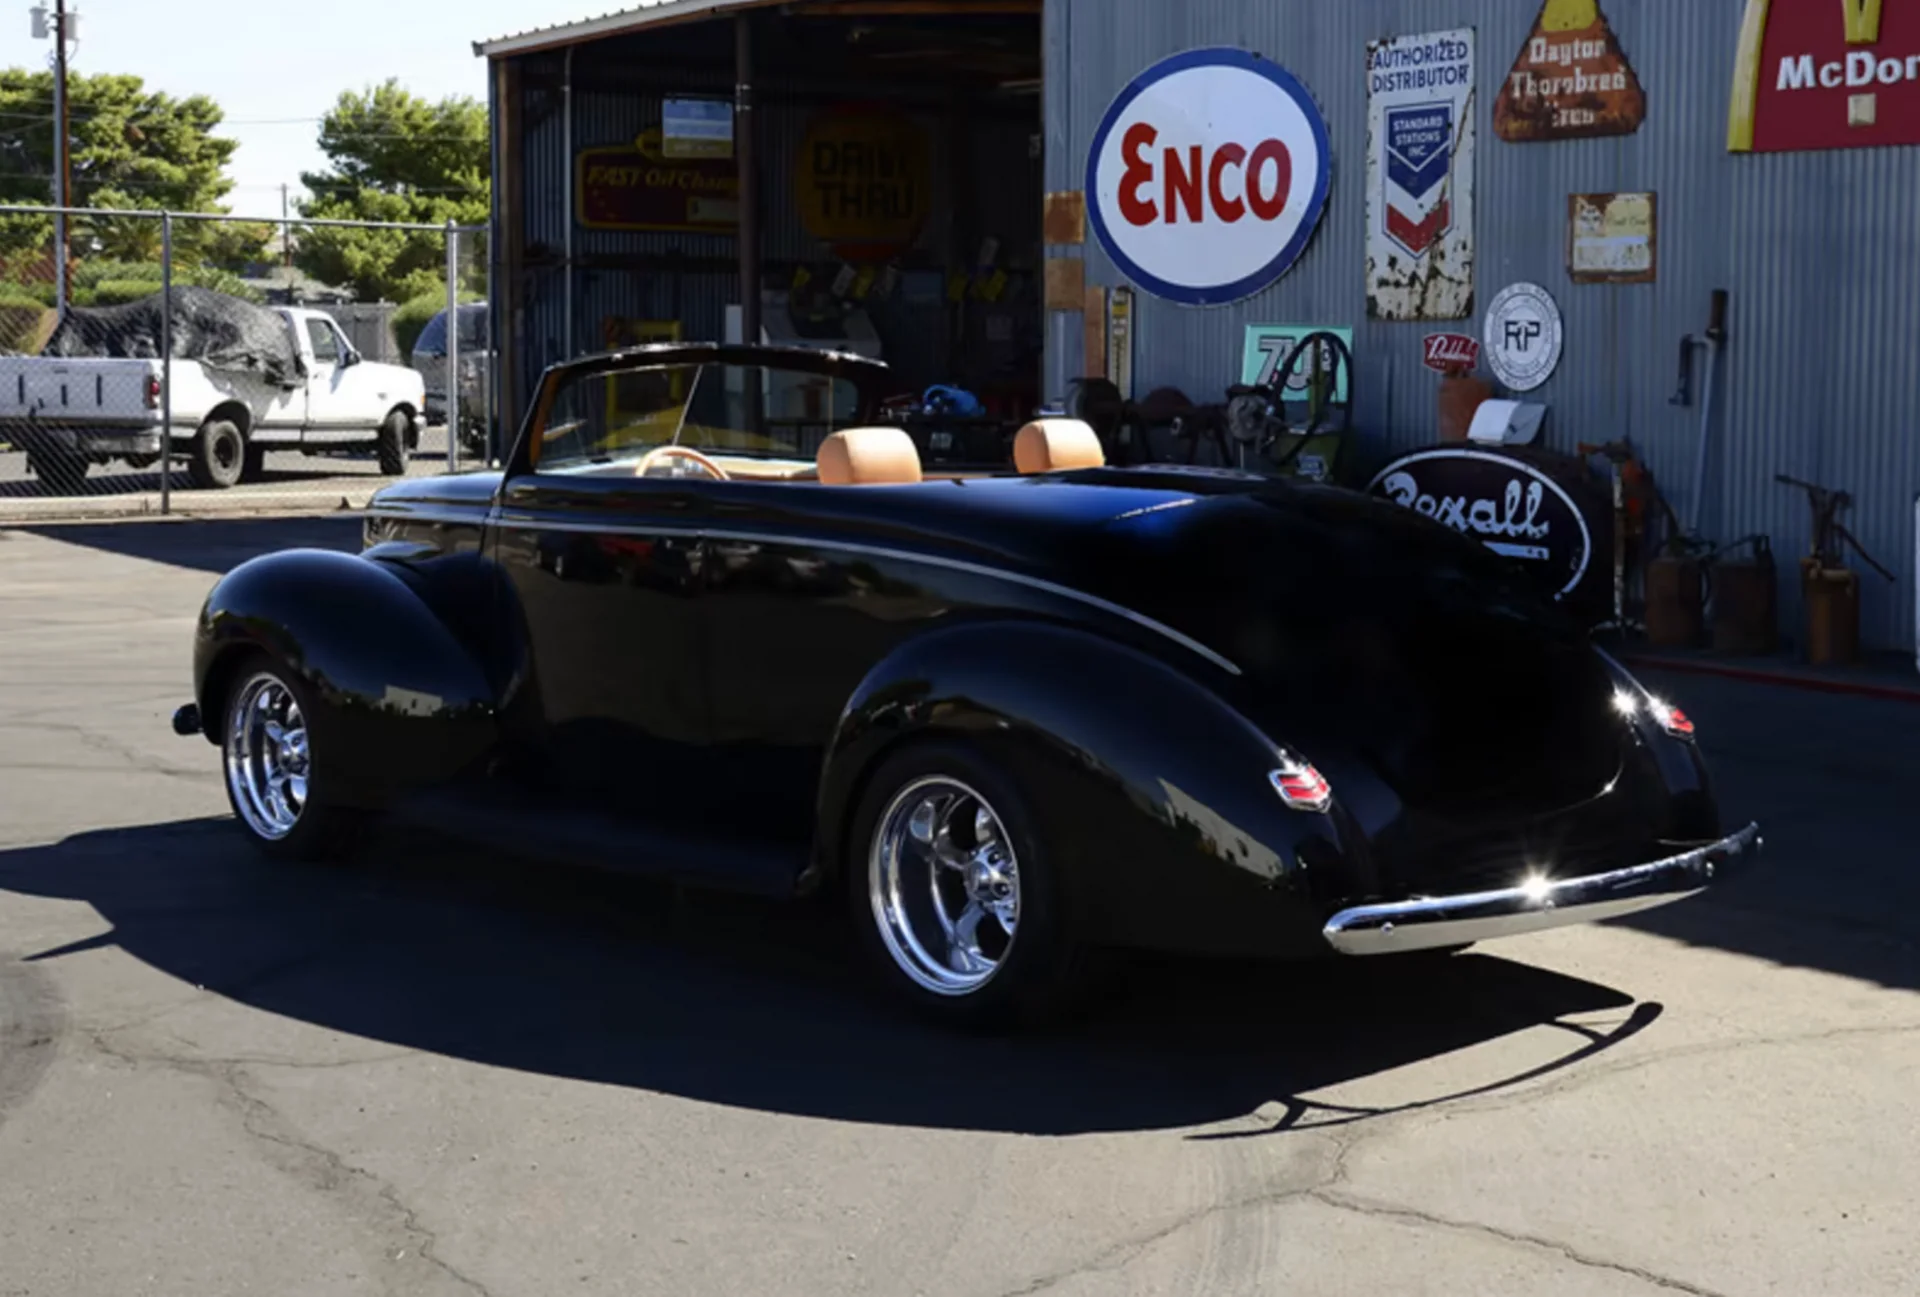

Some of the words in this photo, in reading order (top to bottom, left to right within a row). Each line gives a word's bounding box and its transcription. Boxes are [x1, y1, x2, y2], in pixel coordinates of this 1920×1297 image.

[1373, 39, 1469, 70] AUTHORIZED
[1372, 63, 1470, 93] DISTRIBUTOR
[1393, 115, 1443, 131] STANDARD
[1394, 129, 1441, 146] STATIONS
[587, 165, 642, 188] FAST
[1118, 122, 1292, 227] ENCO
[813, 181, 915, 219] THRU
